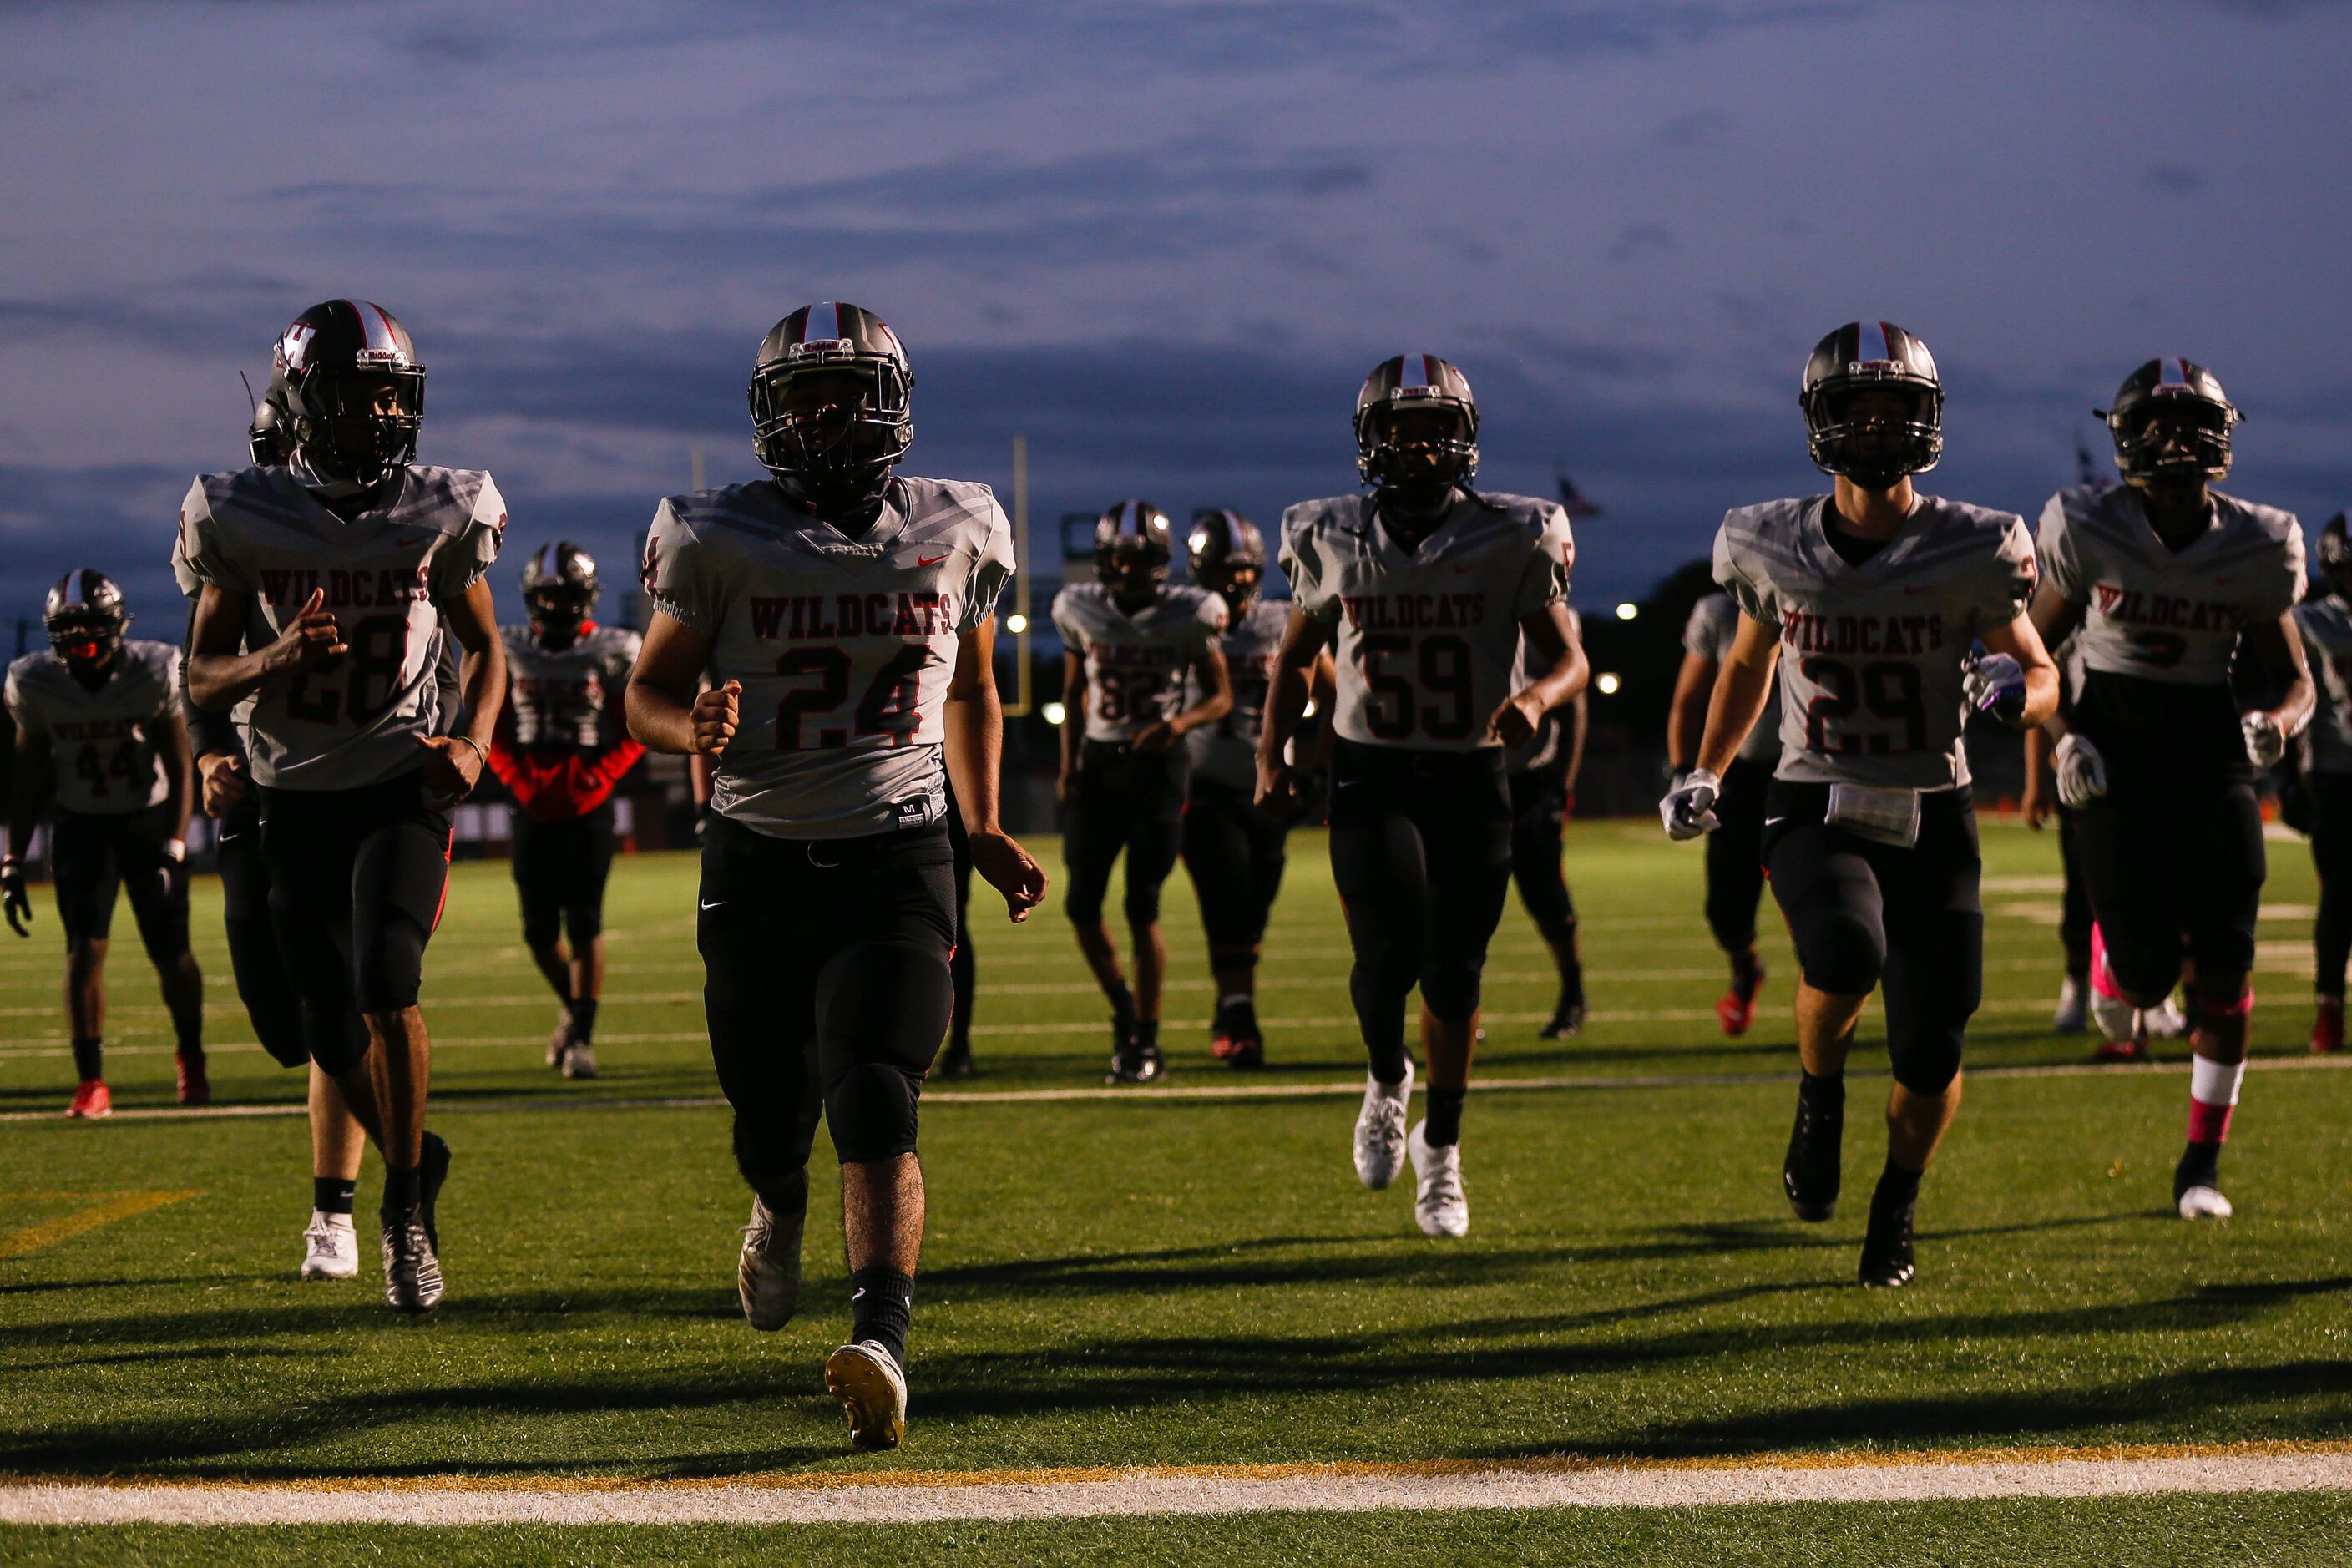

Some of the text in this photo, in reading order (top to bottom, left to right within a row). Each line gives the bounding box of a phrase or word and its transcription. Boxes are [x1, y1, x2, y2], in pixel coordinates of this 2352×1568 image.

[805, 341, 840, 352] Riddell
[260, 565, 429, 607] WILDCATS
[750, 592, 951, 640] WILDCATS
[1342, 593, 1485, 629] WILDCATS
[1783, 610, 1941, 655] WILDCATS
[776, 645, 930, 749] 24
[1363, 634, 1474, 741] 59
[1800, 657, 1926, 755] 29
[77, 740, 145, 797] 44
[903, 804, 916, 814] M
